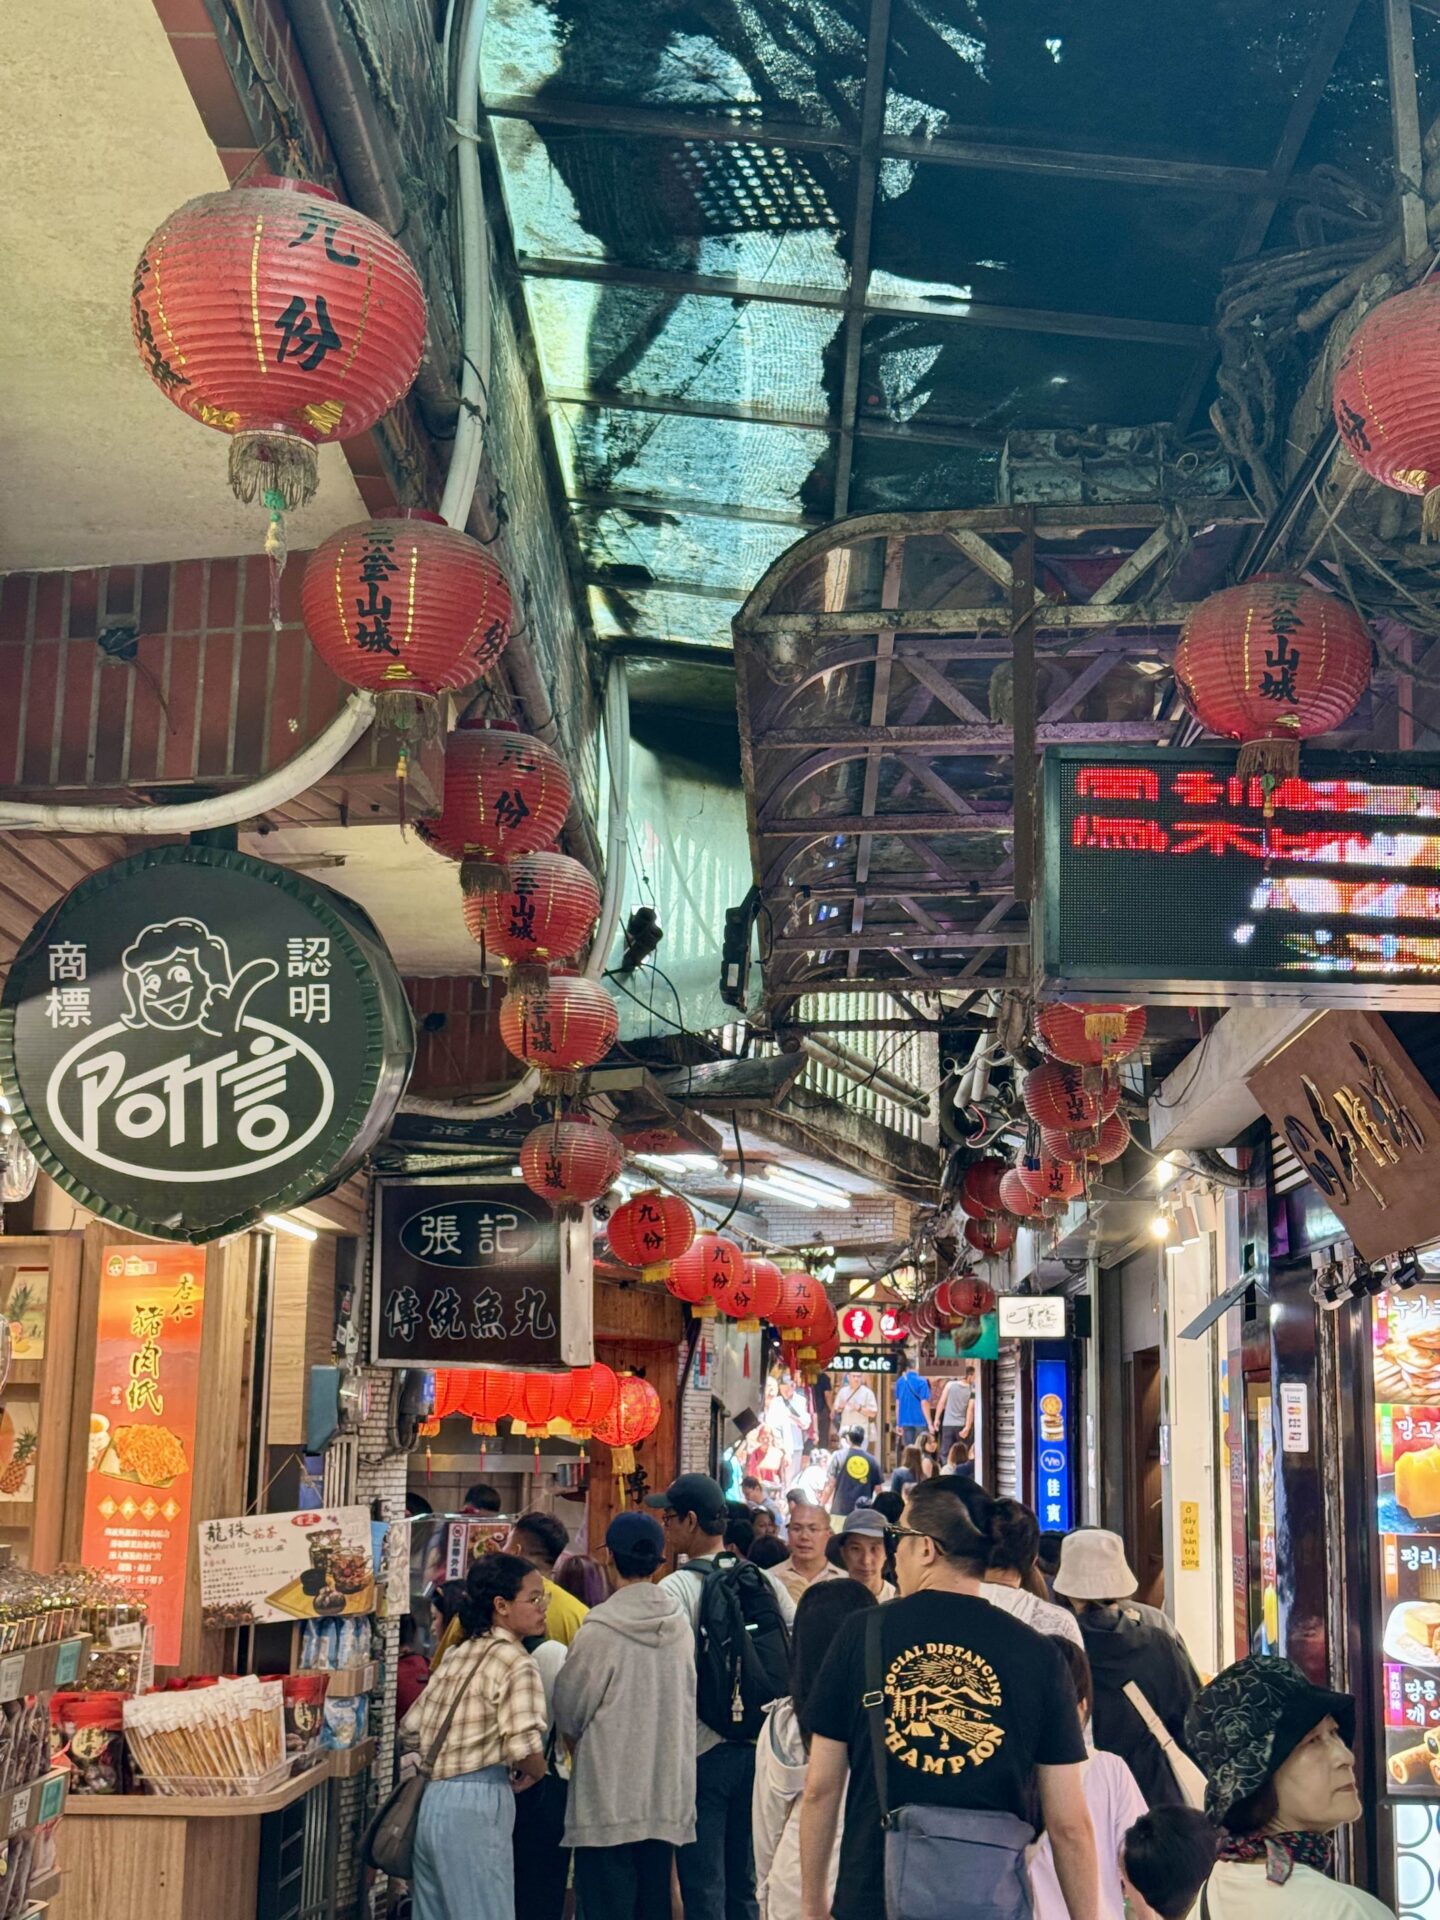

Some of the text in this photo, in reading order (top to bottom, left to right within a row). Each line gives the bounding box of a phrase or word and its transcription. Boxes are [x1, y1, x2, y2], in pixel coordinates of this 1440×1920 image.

[274, 206, 361, 372] 九份
[493, 740, 537, 829] 九份
[45, 940, 92, 1029] 商標
[286, 936, 331, 1025] 認明
[419, 1213, 519, 1256] 張記
[638, 1204, 664, 1250] 九份
[711, 1246, 730, 1290] 九份
[171, 1276, 195, 1322] 杏仁
[384, 1285, 557, 1343] 傳統魚丸
[794, 1282, 811, 1320] 九份
[128, 1305, 165, 1415] 豬肉紙
[827, 1356, 891, 1371] &B Cafe
[1395, 1415, 1440, 1441] 망고
[1400, 1545, 1440, 1571] 펑리
[884, 1642, 1003, 1708] SOCIAL DISTANCING
[1404, 1678, 1437, 1703] 땅콩
[884, 1717, 1006, 1776] CHAMPION
